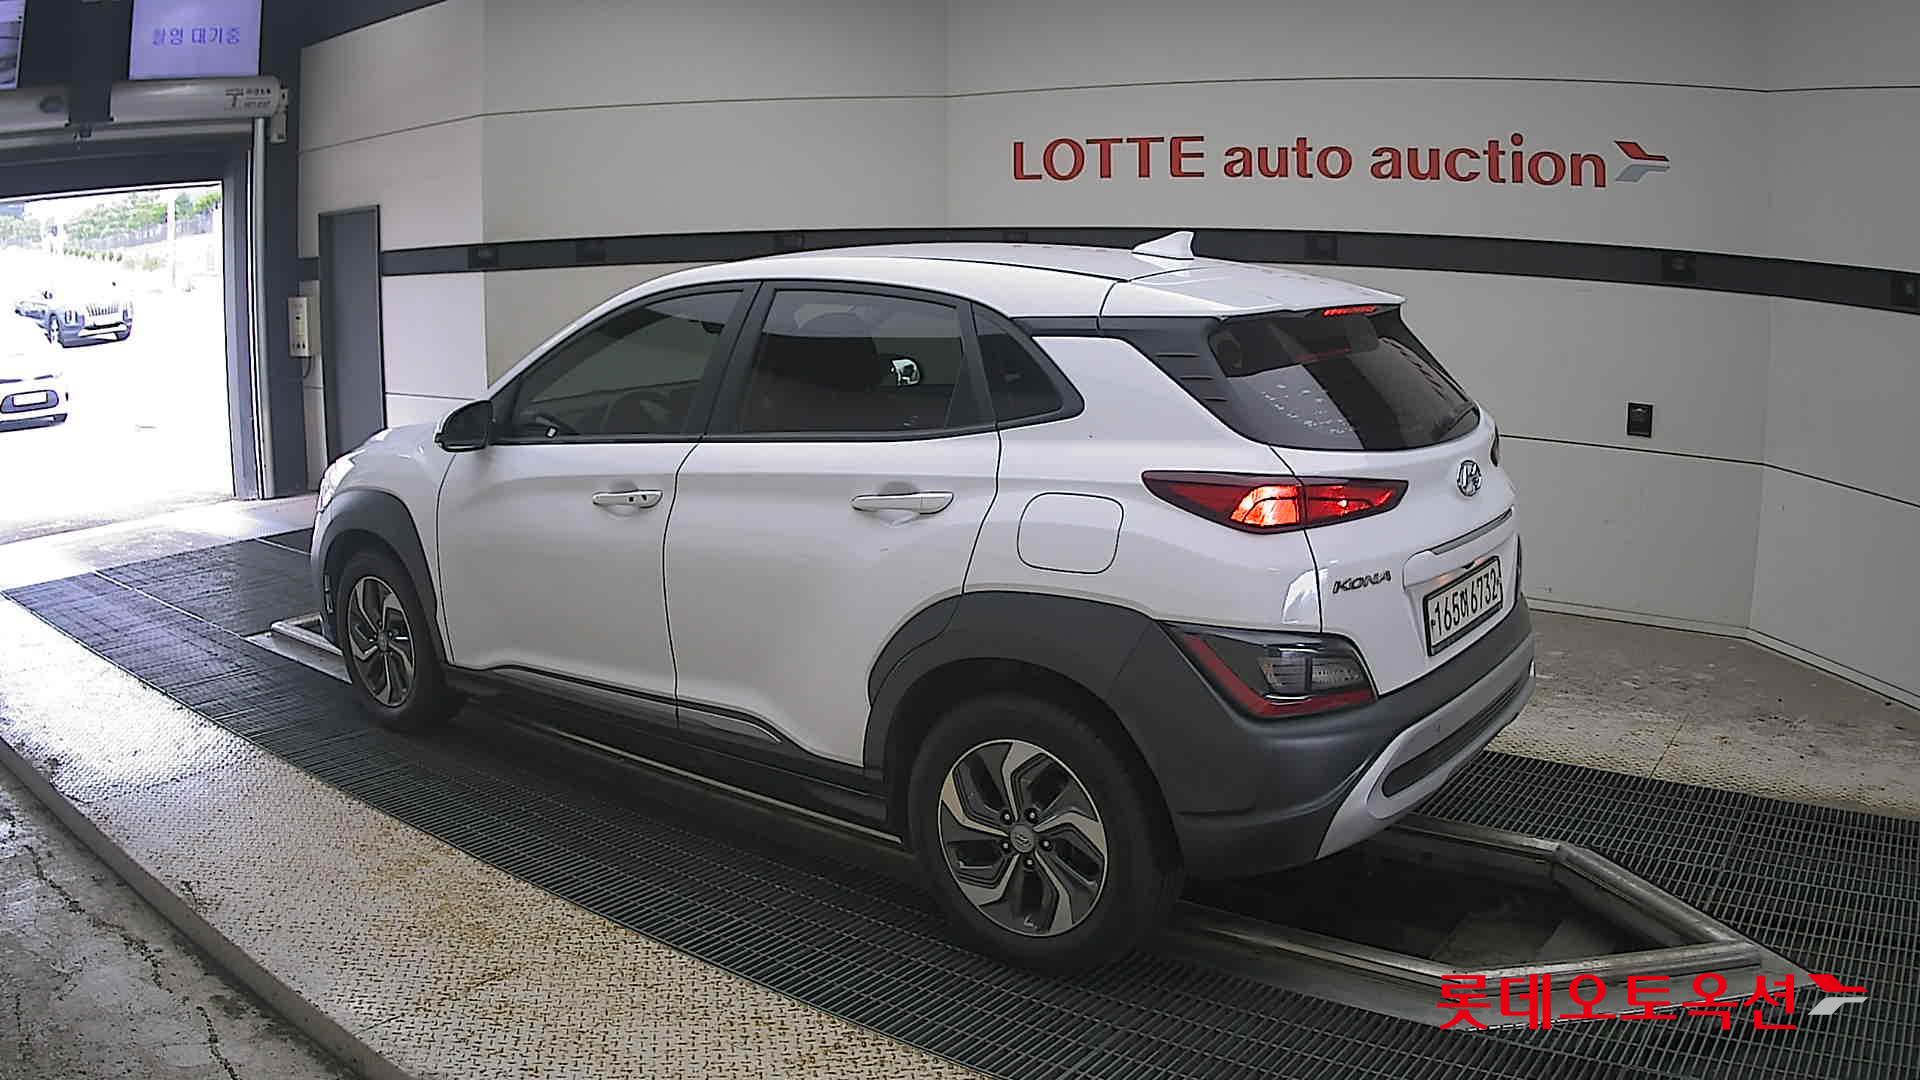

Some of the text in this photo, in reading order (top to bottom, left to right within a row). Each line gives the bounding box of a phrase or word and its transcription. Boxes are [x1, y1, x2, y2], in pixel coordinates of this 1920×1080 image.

[1013, 134, 1607, 188] LOTTE auto auction
[1333, 570, 1392, 594] KONA
